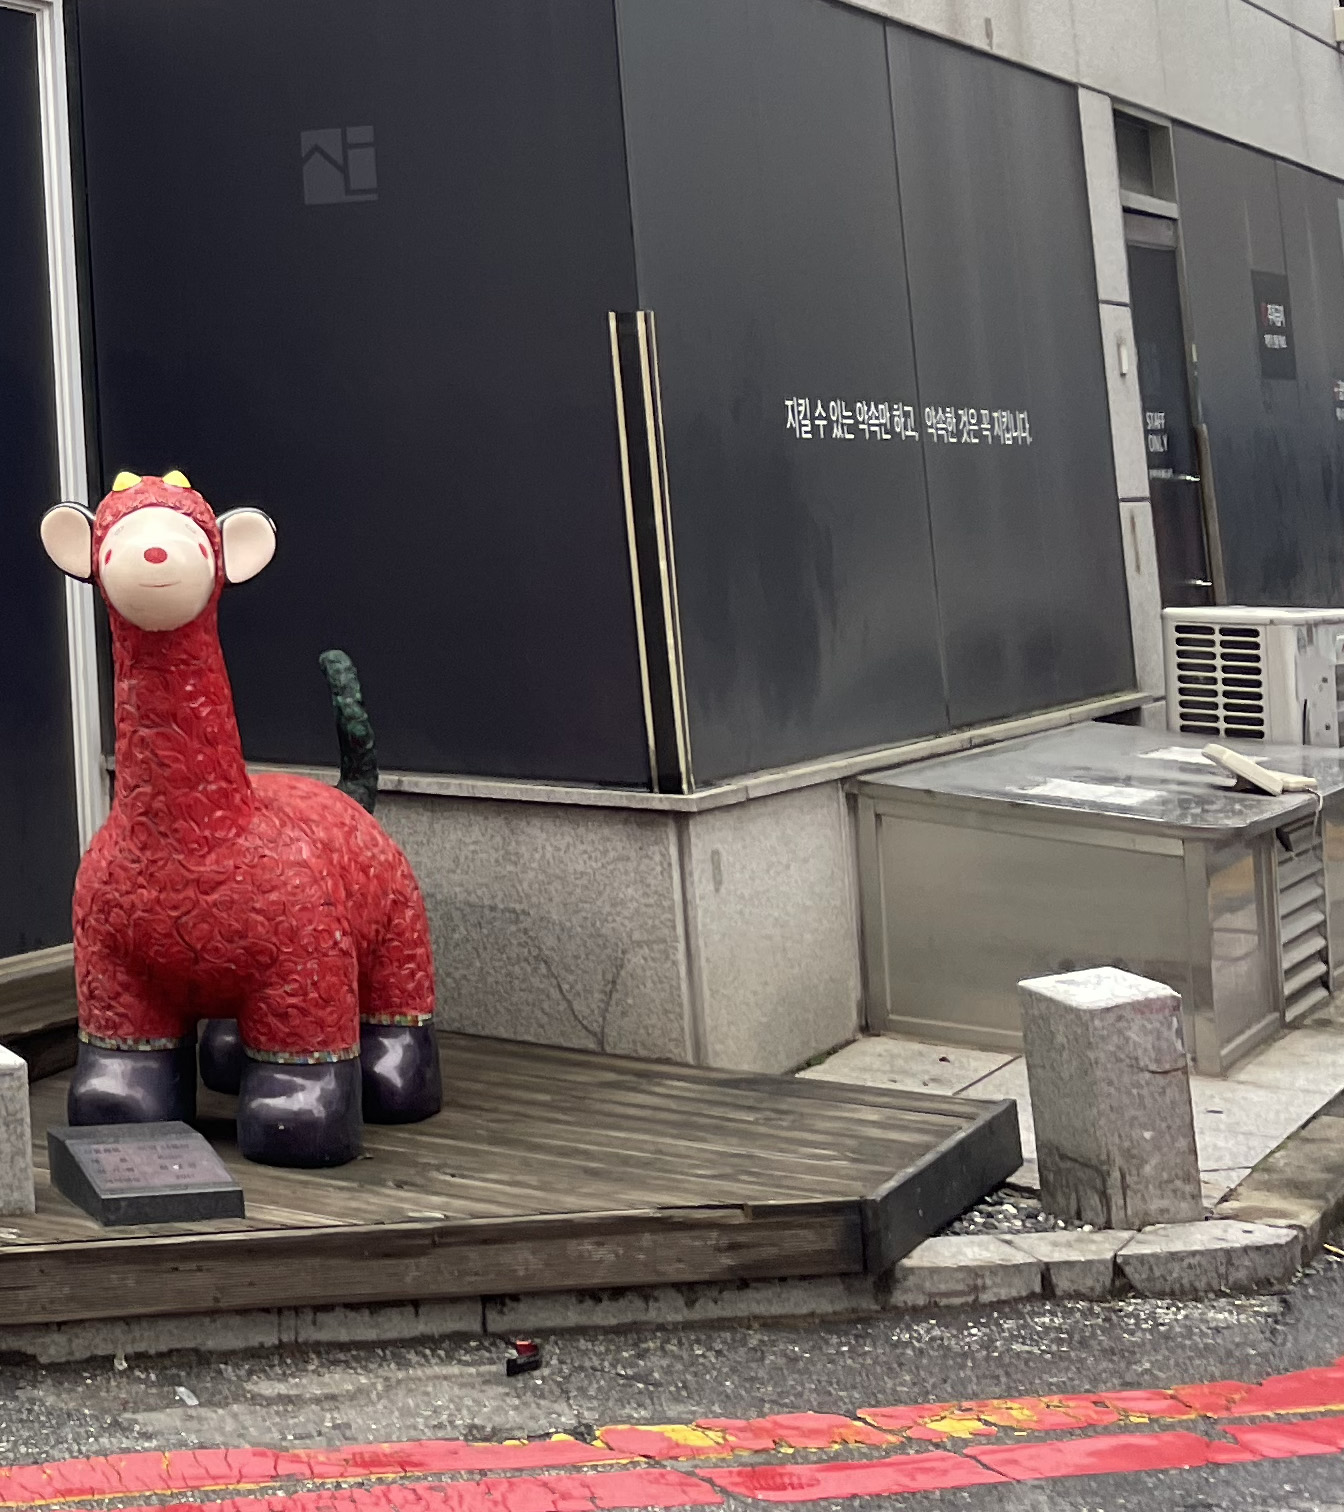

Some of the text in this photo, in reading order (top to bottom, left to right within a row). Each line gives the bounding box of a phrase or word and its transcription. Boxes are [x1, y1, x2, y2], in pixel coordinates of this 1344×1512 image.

[784, 397, 812, 439] 지킬
[814, 399, 827, 434] 수
[830, 399, 854, 439] 있는
[856, 400, 891, 440] 약속만
[925, 405, 956, 443] 약속한
[959, 407, 979, 443] 것은
[981, 409, 991, 444] 꼭
